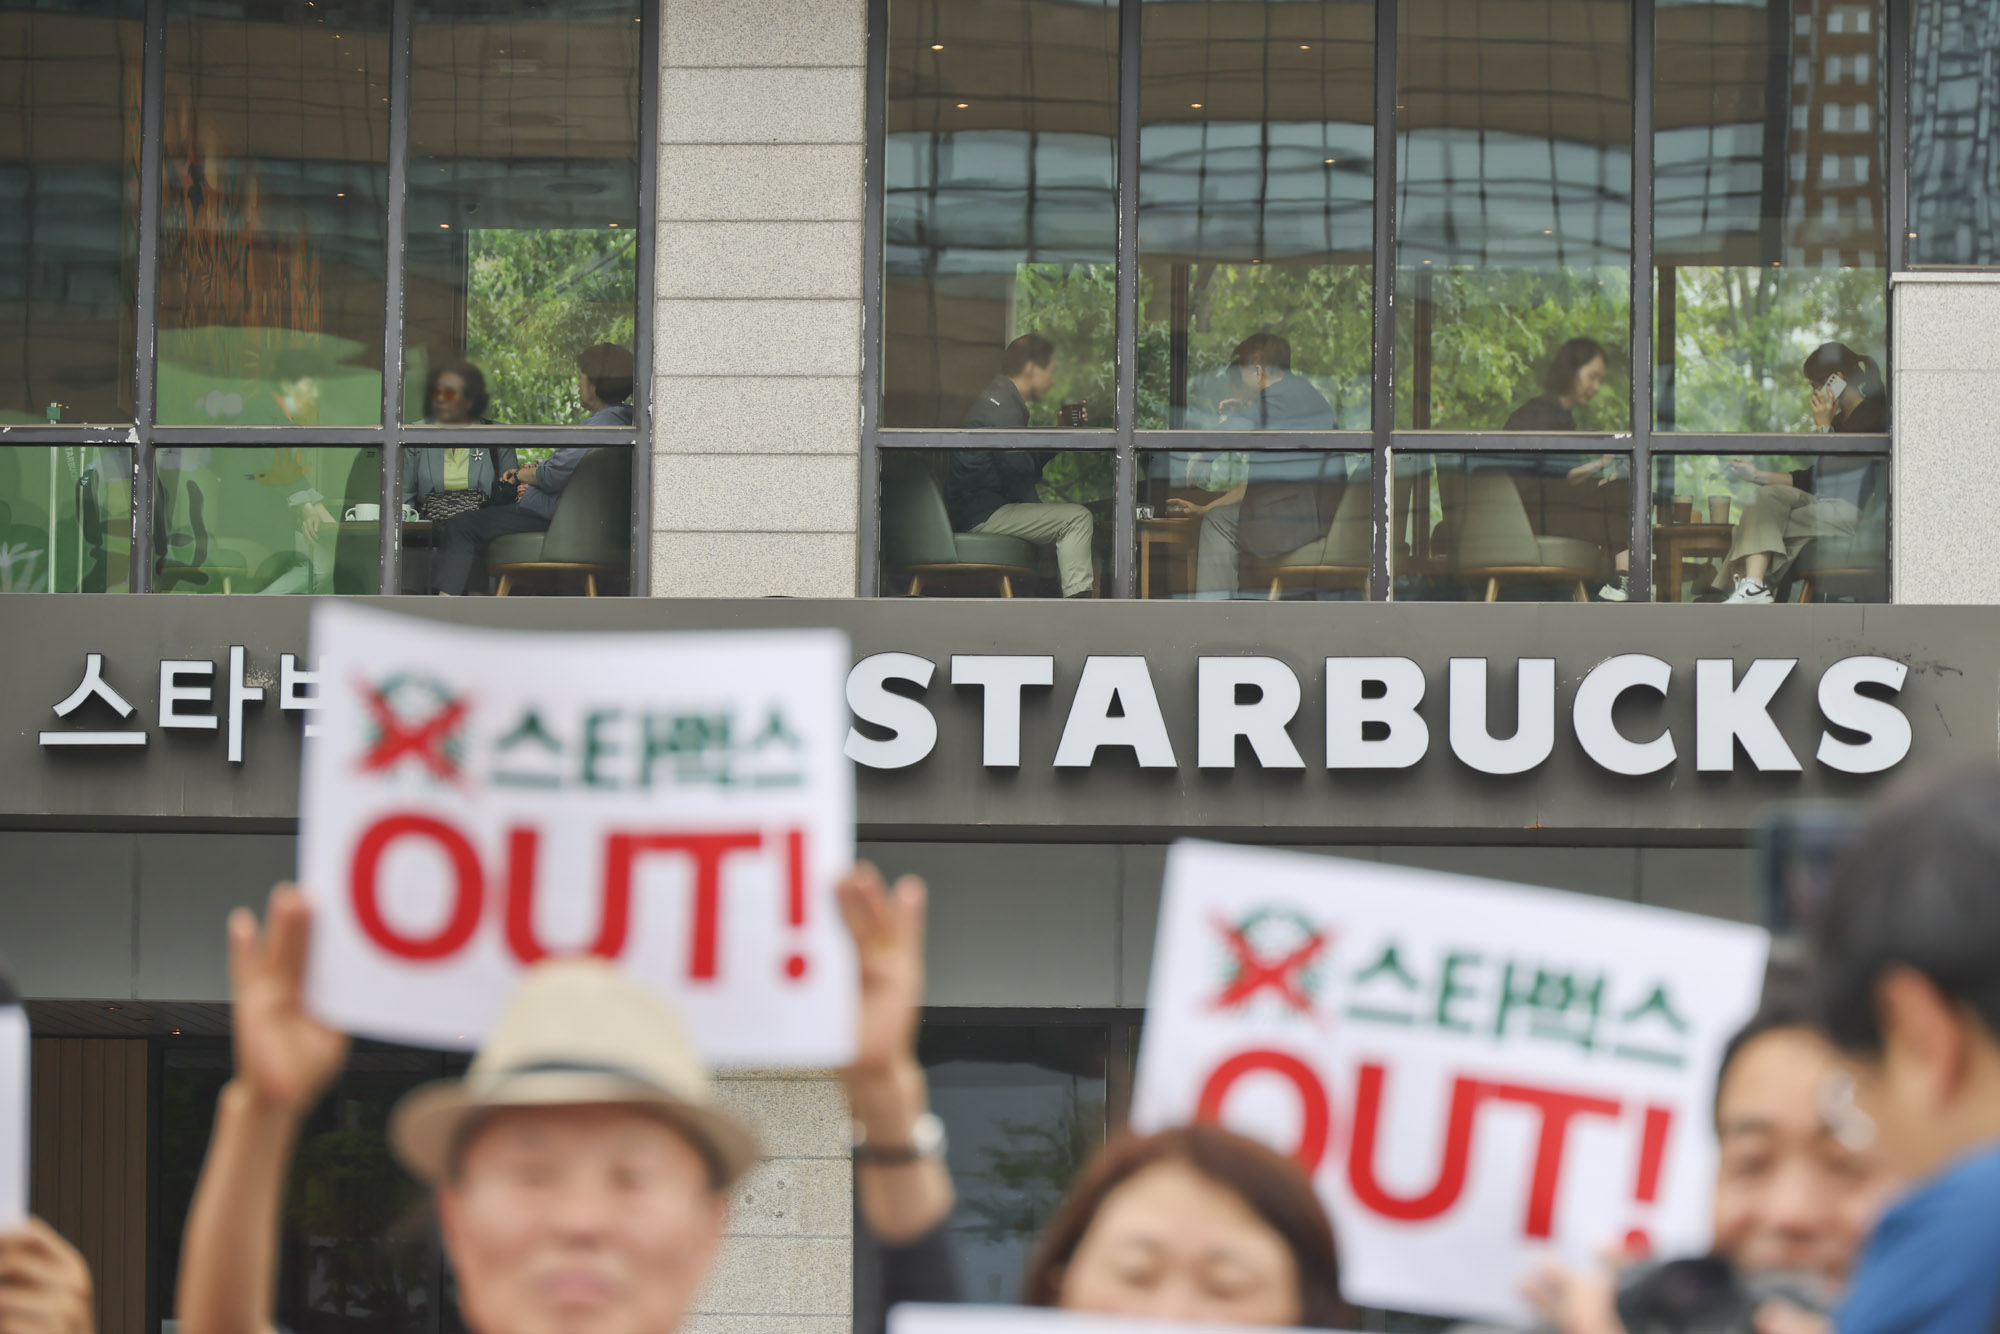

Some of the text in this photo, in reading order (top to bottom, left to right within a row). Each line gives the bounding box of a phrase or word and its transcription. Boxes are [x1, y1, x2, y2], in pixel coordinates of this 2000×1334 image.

[489, 701, 805, 792] 스타벅스
[844, 651, 1913, 776] STARBUCKS
[346, 809, 810, 985] OUT!
[1346, 938, 1692, 1068] 스타벅스
